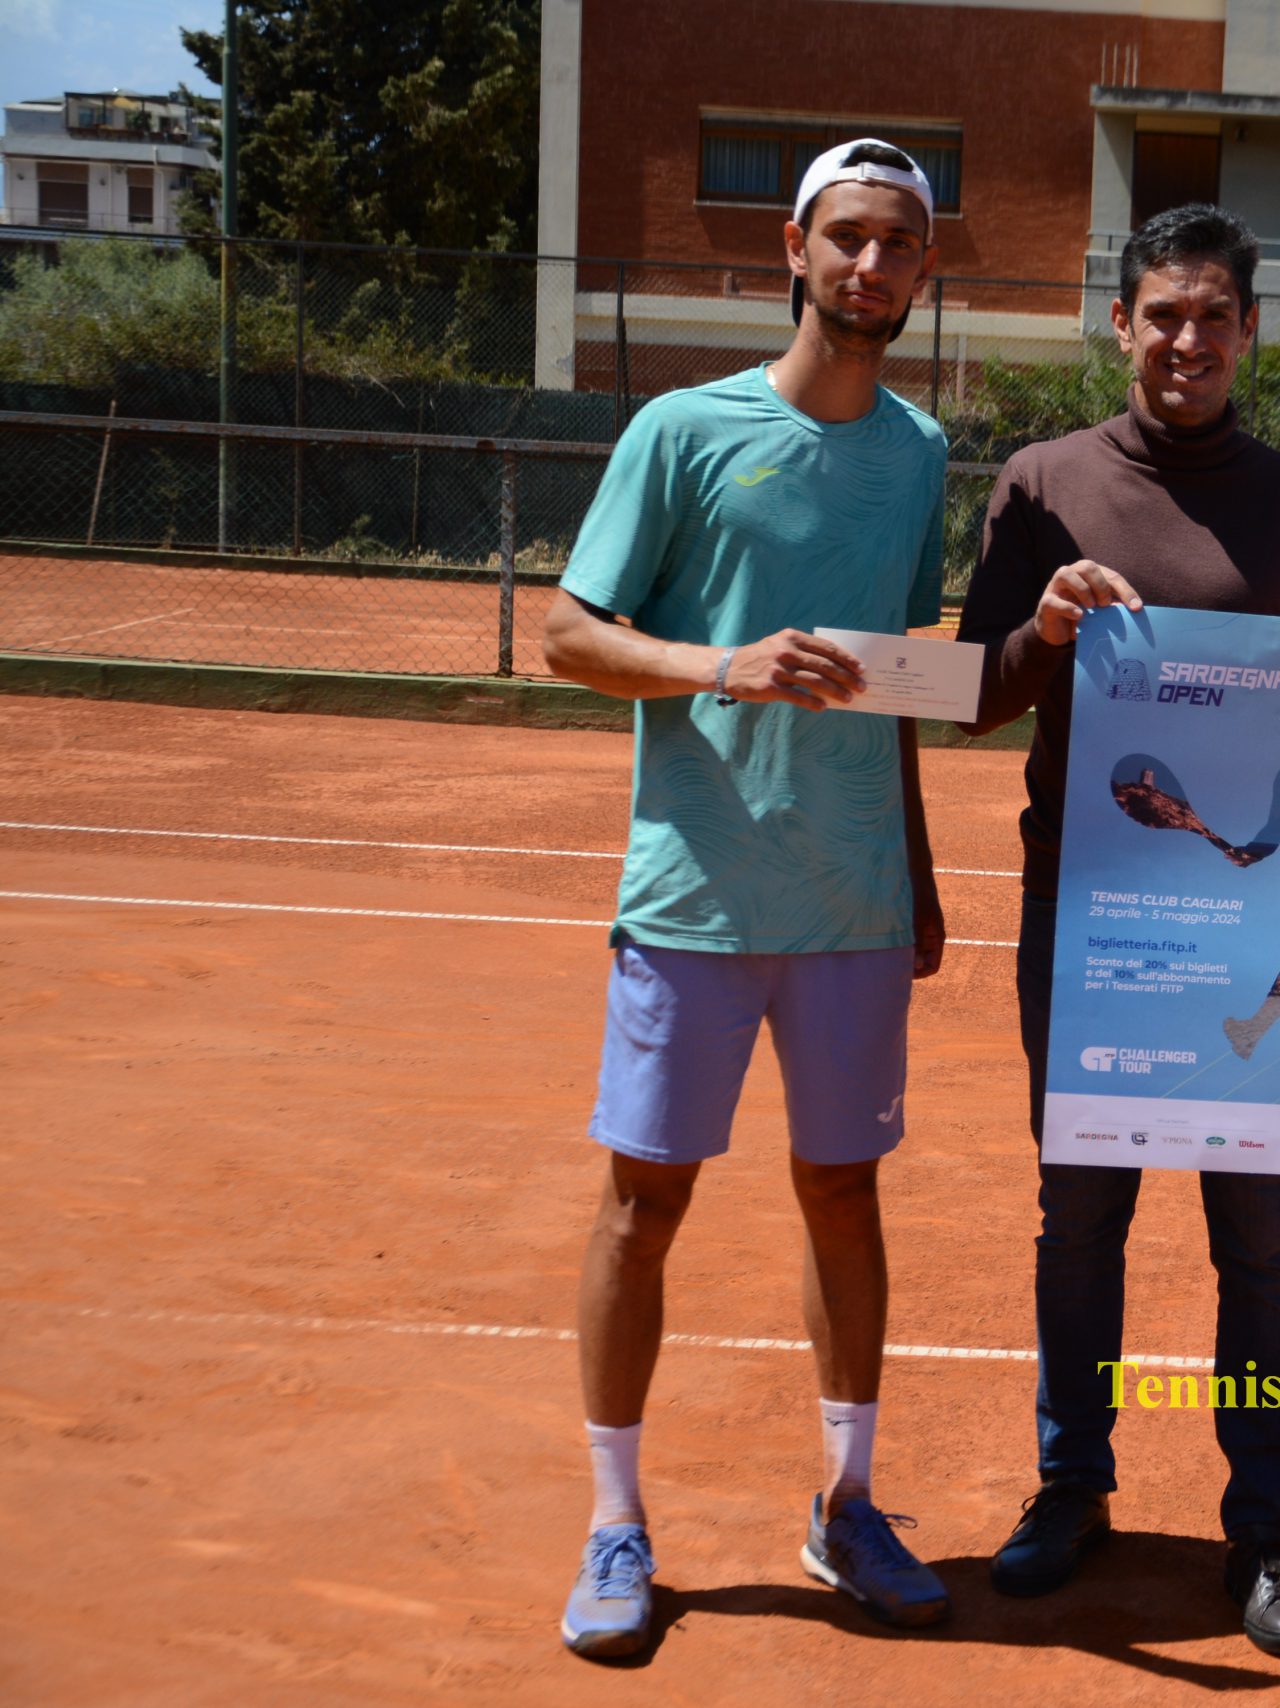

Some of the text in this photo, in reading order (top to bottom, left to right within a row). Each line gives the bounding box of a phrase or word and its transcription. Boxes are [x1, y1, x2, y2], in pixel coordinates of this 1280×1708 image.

[1157, 684, 1224, 707] OPEN
[1091, 891, 1243, 911] TENNIS CLUB CAGLIARI
[1089, 905, 1104, 916] 29
[1106, 907, 1141, 919] aprile
[1151, 909, 1160, 920] 5
[1162, 911, 1209, 925] maggio
[1212, 912, 1241, 925] 2024
[1088, 936, 1197, 954] biglietteria.fitp.it
[1086, 956, 1227, 975] Sconto del 20% sui biglietti
[1086, 968, 1232, 986] e del 10% sull'abbonamento
[1085, 981, 1103, 992] per
[1112, 981, 1158, 992] Tesserati
[1161, 984, 1184, 993] FITP
[1118, 1048, 1197, 1064] CHALLENGER
[1118, 1061, 1152, 1074] TOUR
[1075, 1132, 1119, 1141] SARDEGNA
[1238, 1139, 1265, 1149] Wilson
